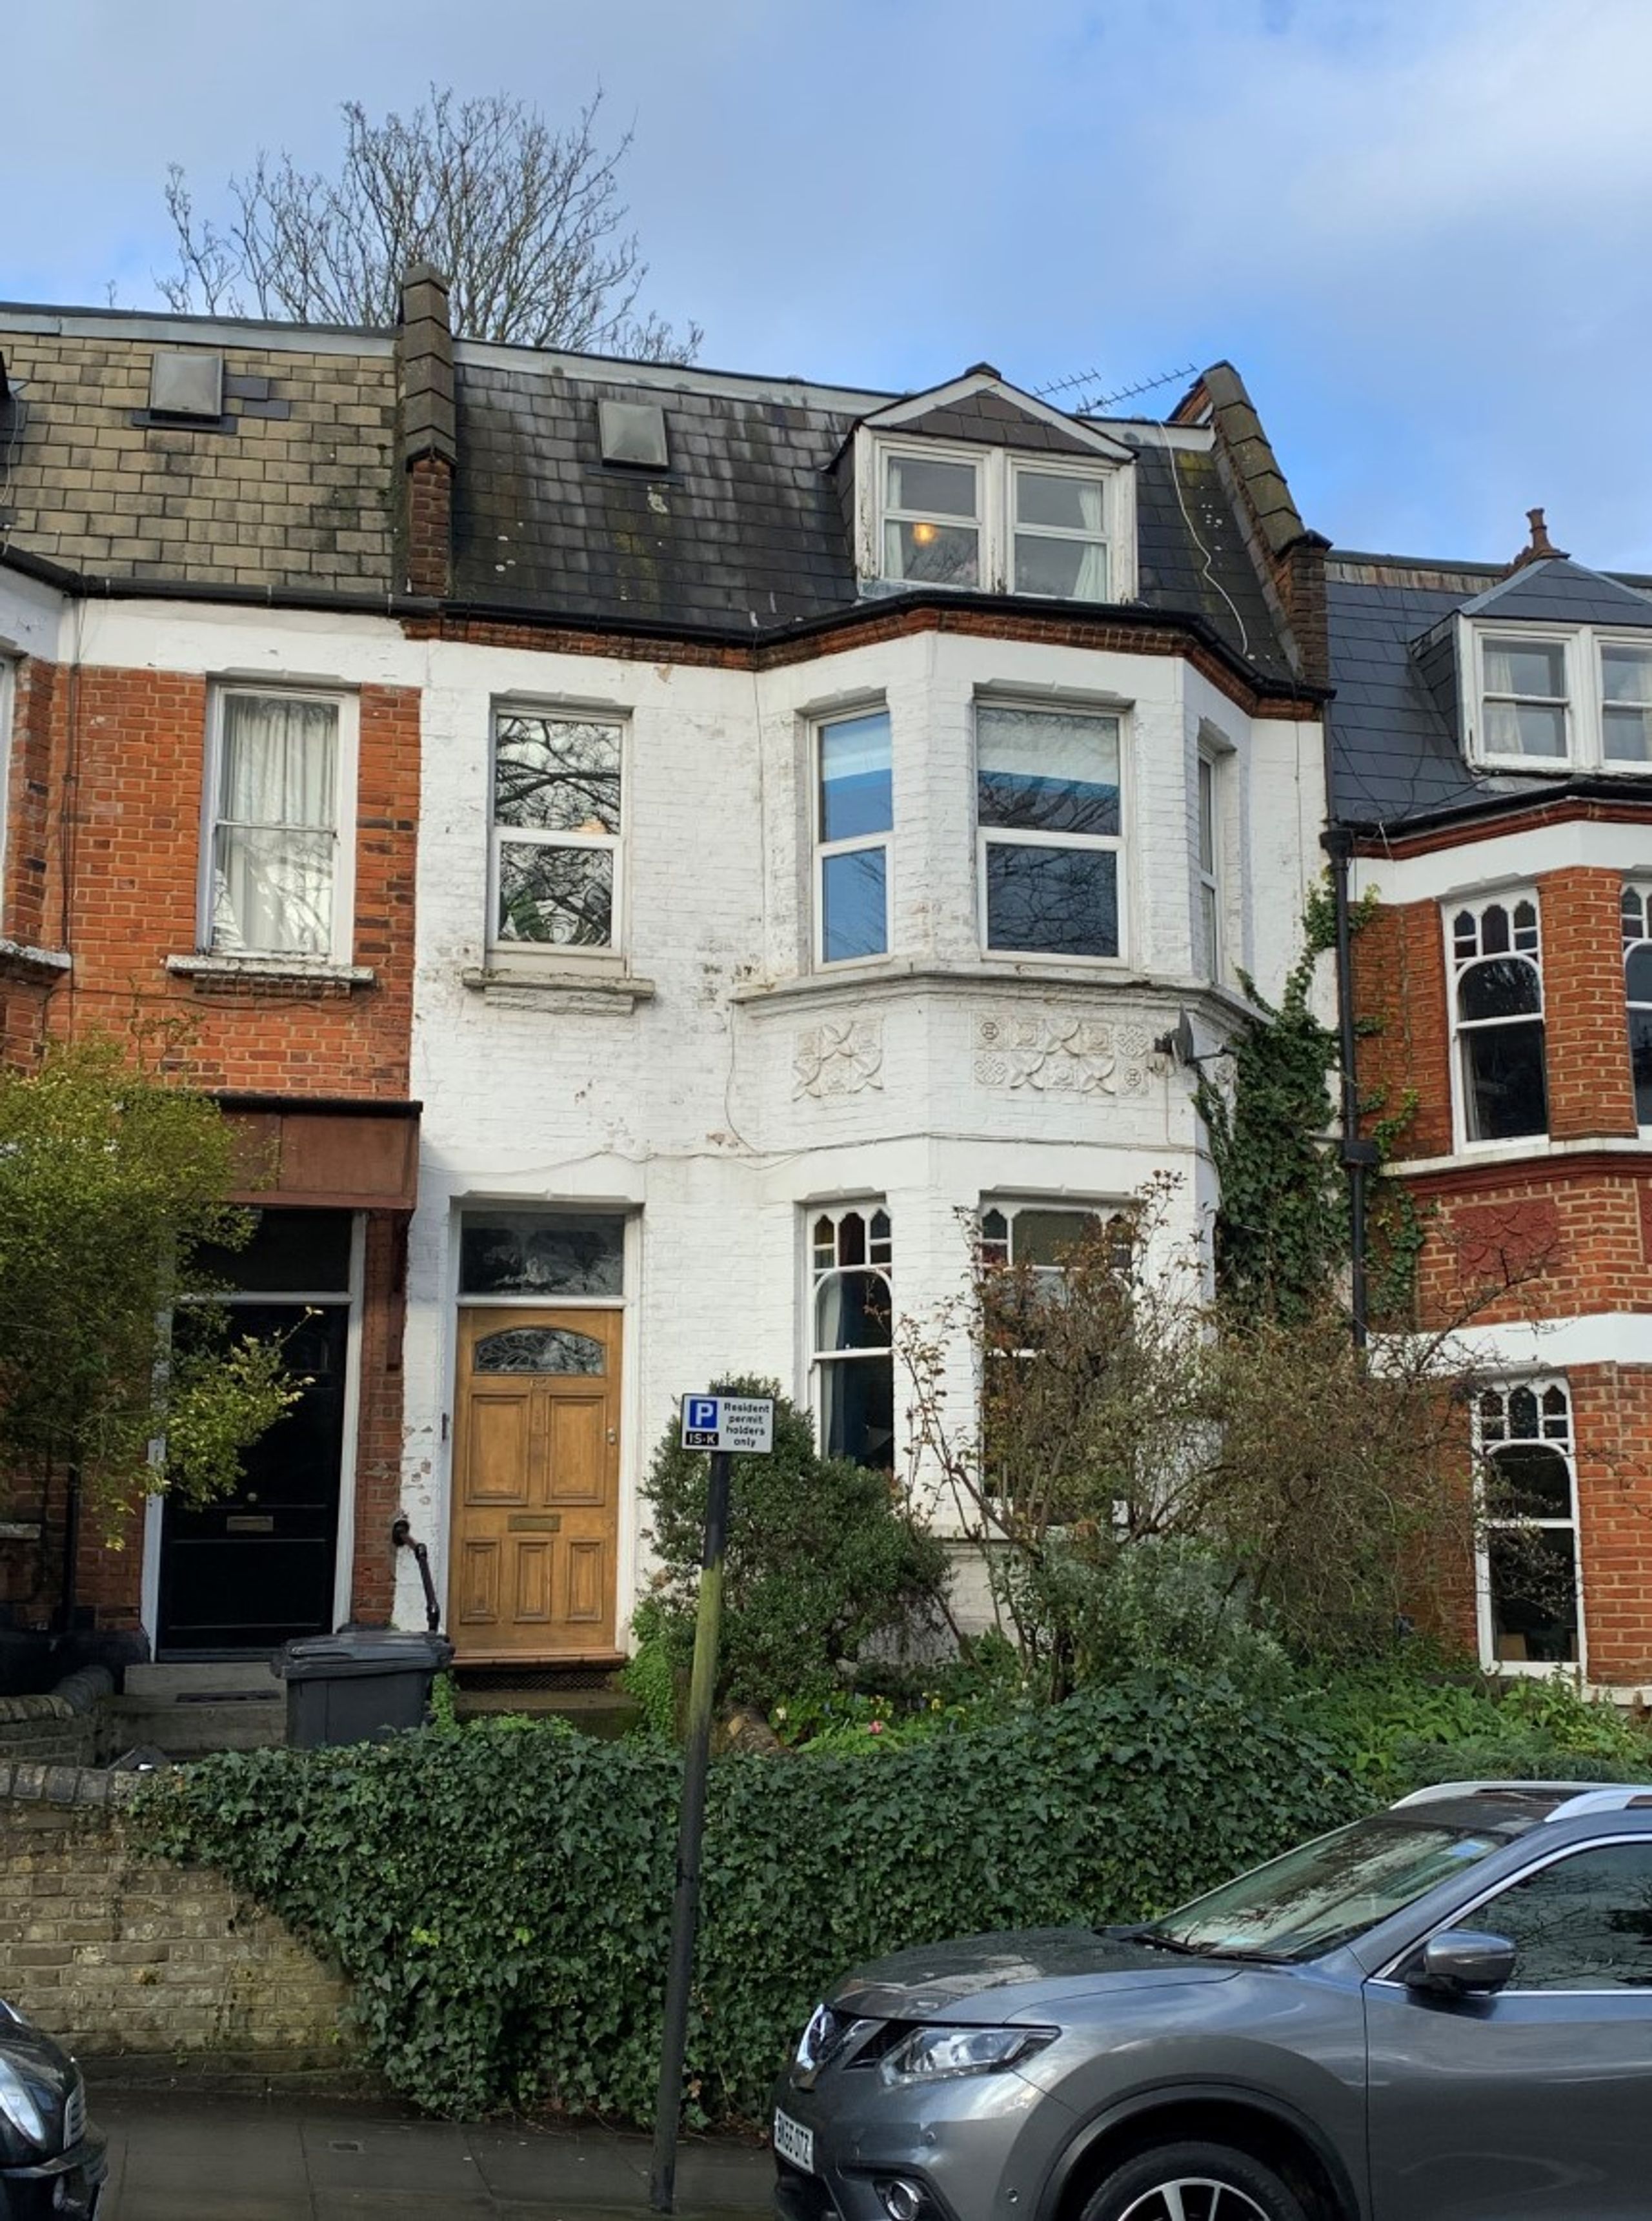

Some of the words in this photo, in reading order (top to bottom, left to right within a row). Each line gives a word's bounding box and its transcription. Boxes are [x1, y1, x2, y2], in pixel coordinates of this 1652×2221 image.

[724, 1403, 770, 1413] Resident
[695, 1403, 714, 1426] P
[729, 1415, 763, 1424] permit
[726, 1426, 765, 1435] holders
[734, 1437, 756, 1447] only
